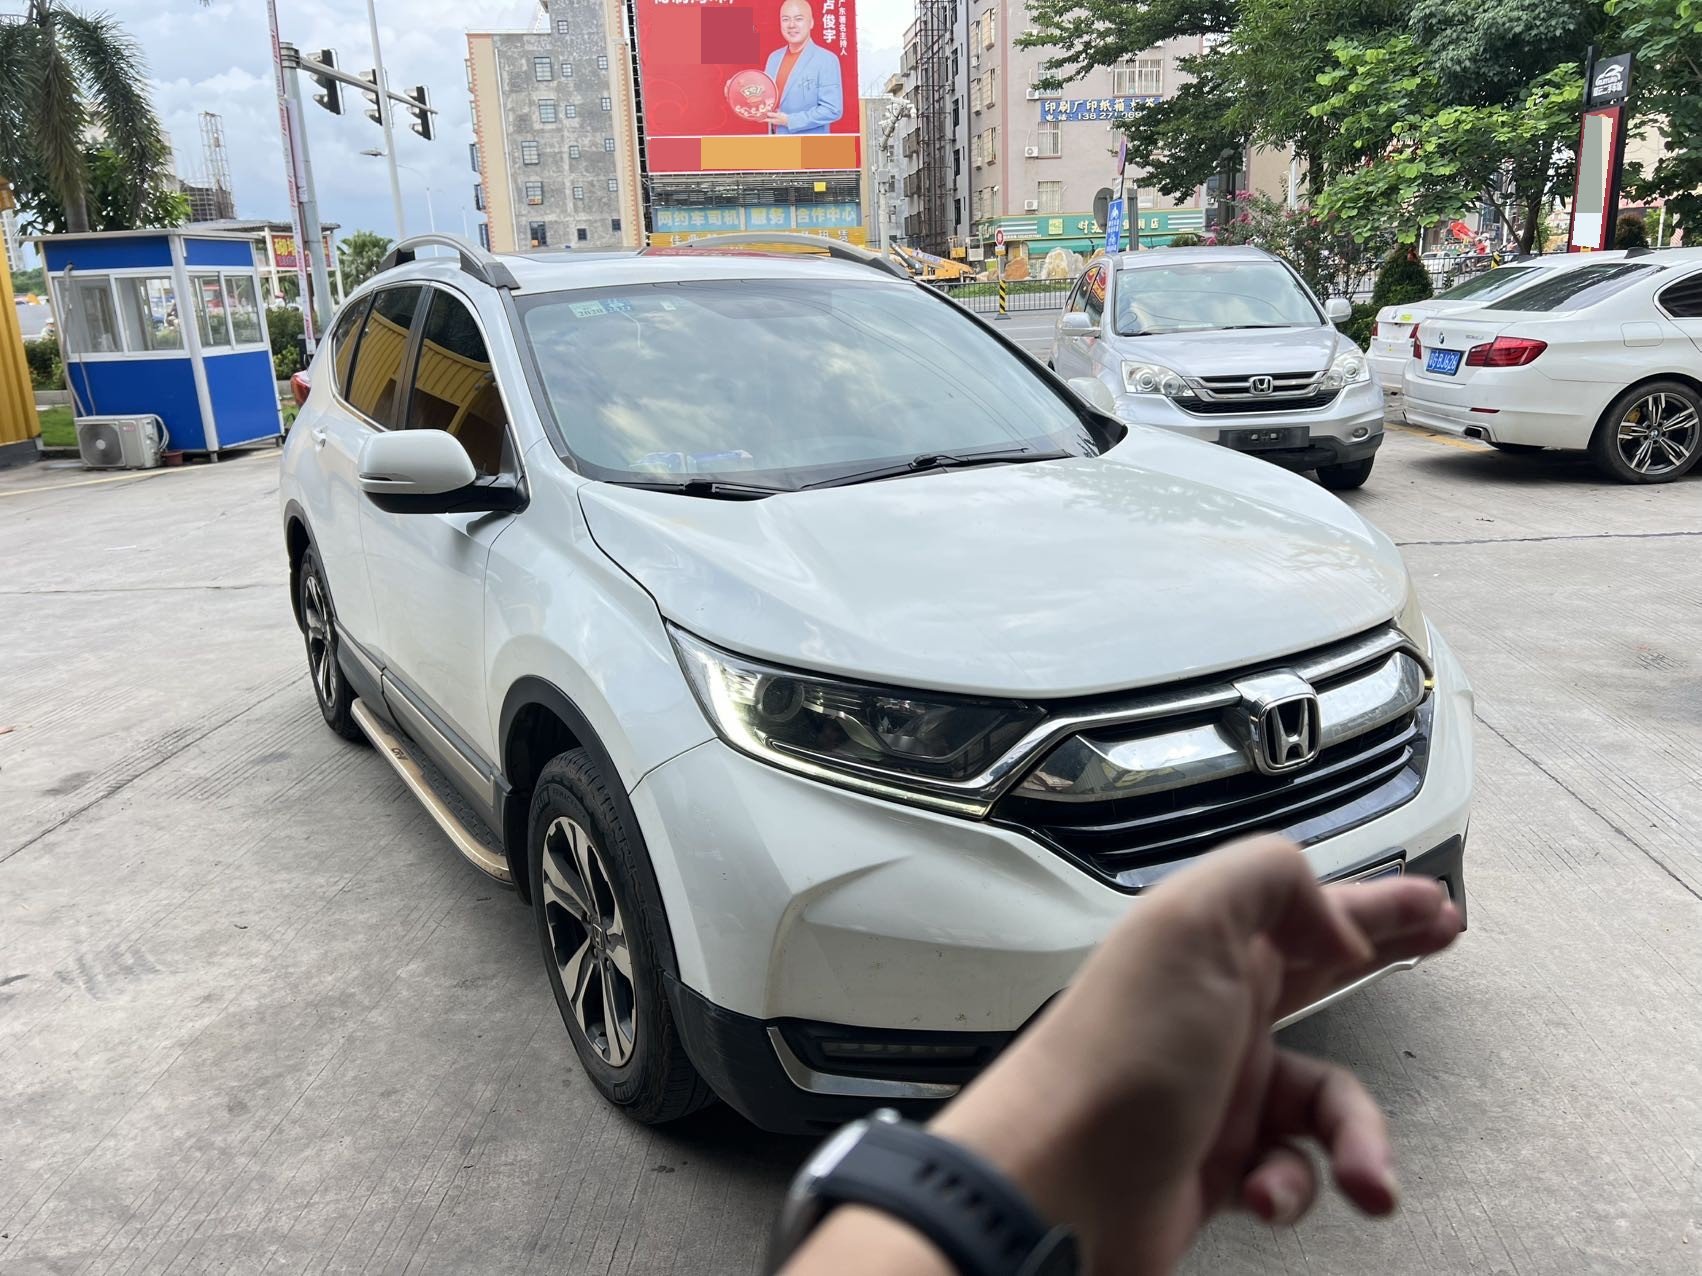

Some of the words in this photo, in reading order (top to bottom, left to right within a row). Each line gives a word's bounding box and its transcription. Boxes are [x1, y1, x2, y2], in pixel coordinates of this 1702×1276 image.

[822, 0, 836, 43] 卢俊宇
[657, 209, 739, 226] 网约车司机
[798, 207, 856, 223] 合作中心
